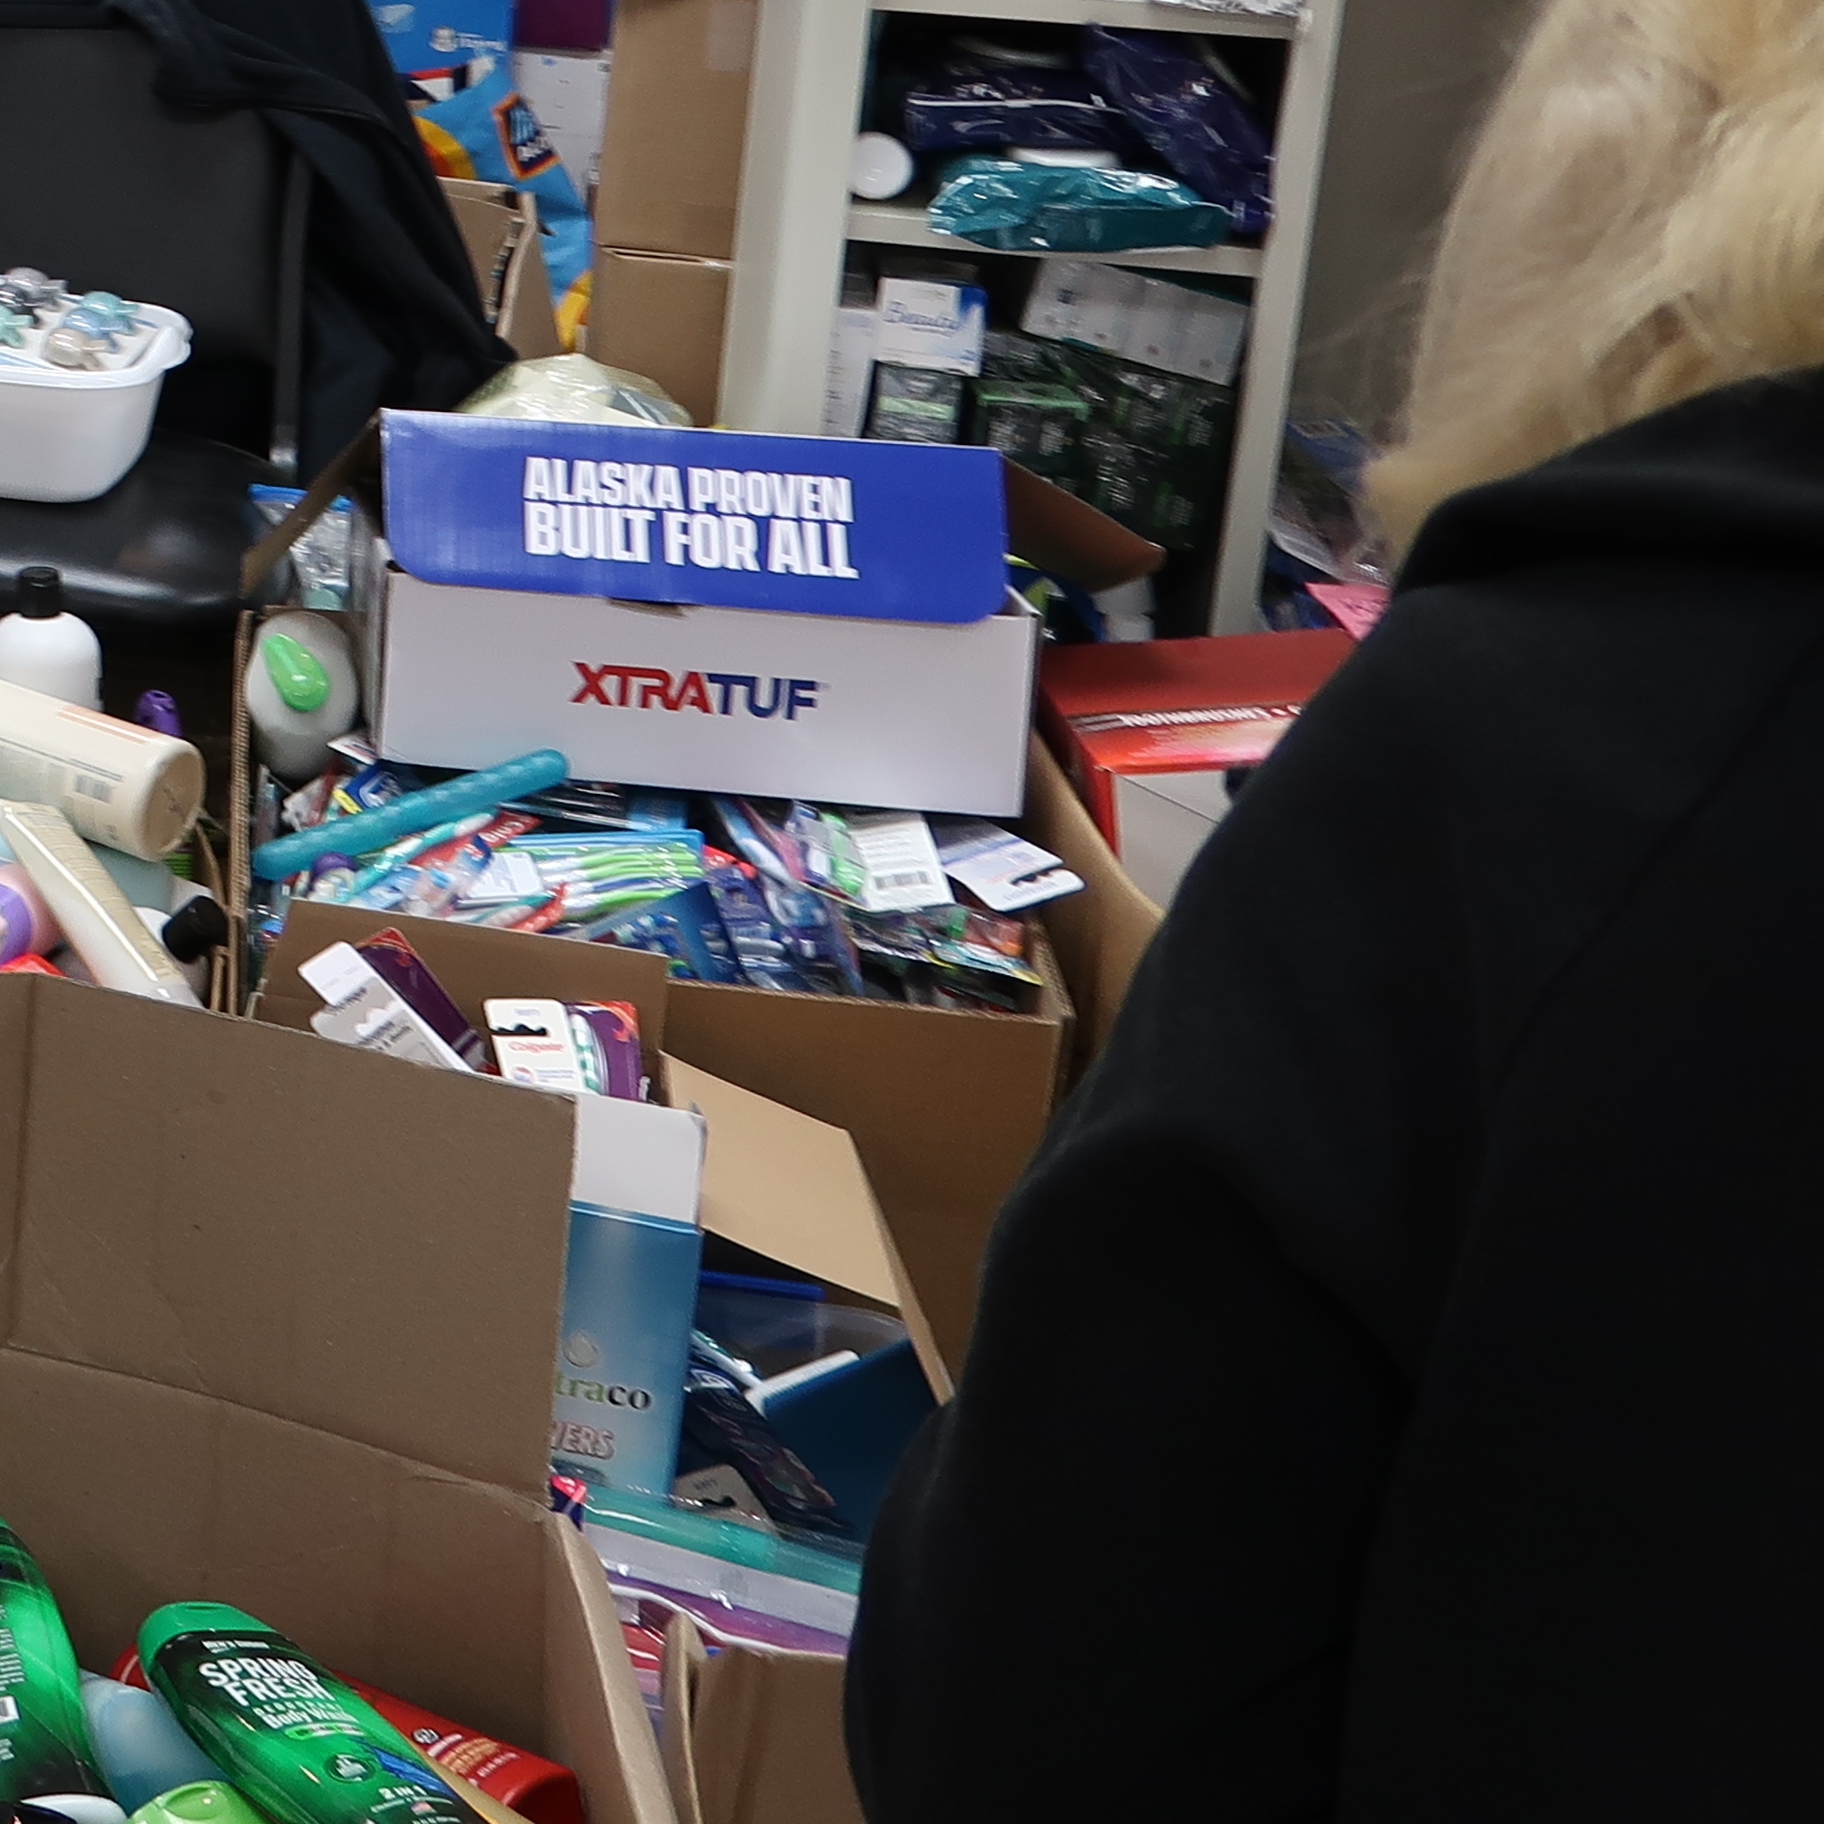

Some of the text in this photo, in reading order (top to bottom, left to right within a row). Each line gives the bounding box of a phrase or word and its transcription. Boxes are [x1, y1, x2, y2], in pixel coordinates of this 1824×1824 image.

[524, 456, 855, 526] ALASKA PROVEN
[524, 502, 859, 580] BUILT FOR ALL
[570, 660, 821, 721] XTRATUF
[553, 1375, 653, 1413] traco
[198, 1657, 319, 1688] SPRING
[224, 1676, 336, 1708] FRESH
[260, 1706, 310, 1730] Body
